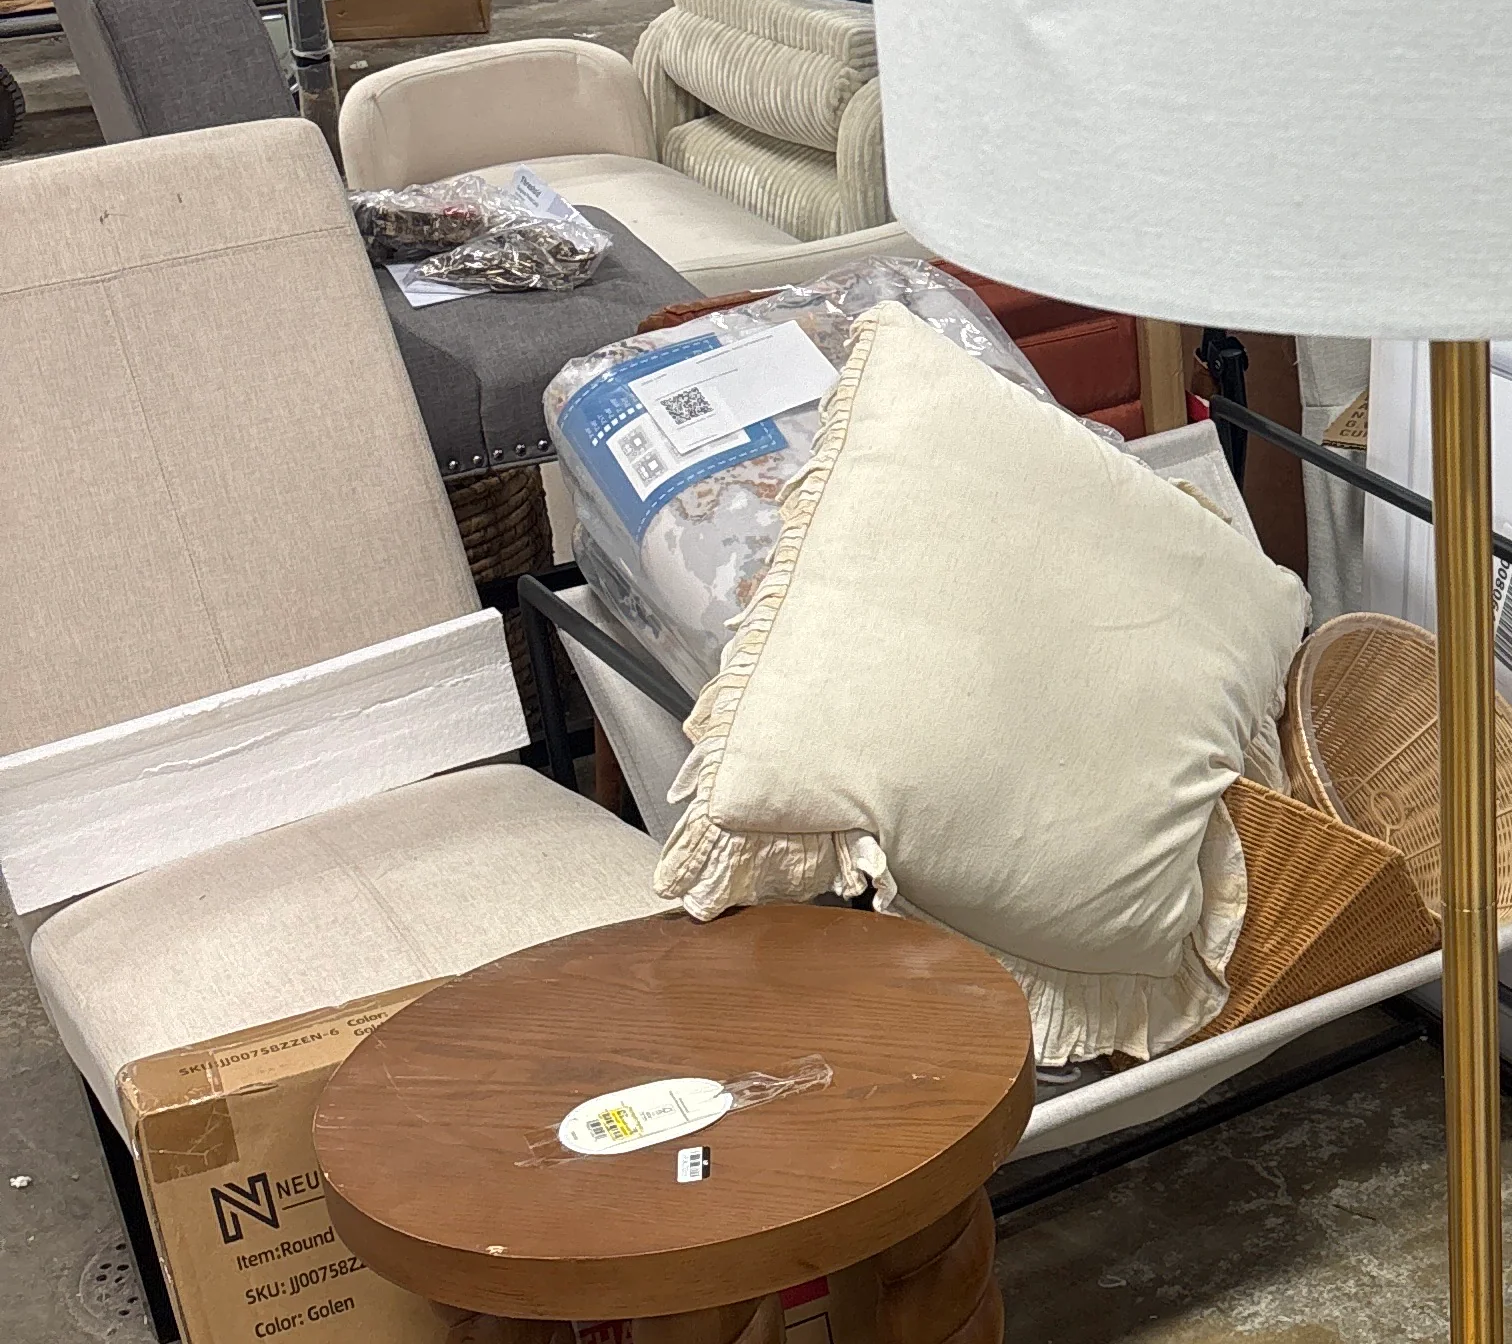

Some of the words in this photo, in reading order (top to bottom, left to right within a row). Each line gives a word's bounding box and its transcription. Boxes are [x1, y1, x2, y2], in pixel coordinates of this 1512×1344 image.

[276, 1170, 320, 1199] NEU
[245, 1281, 287, 1305] SKU:
[254, 1312, 304, 1338] Color:
[307, 1296, 356, 1322] Golen
